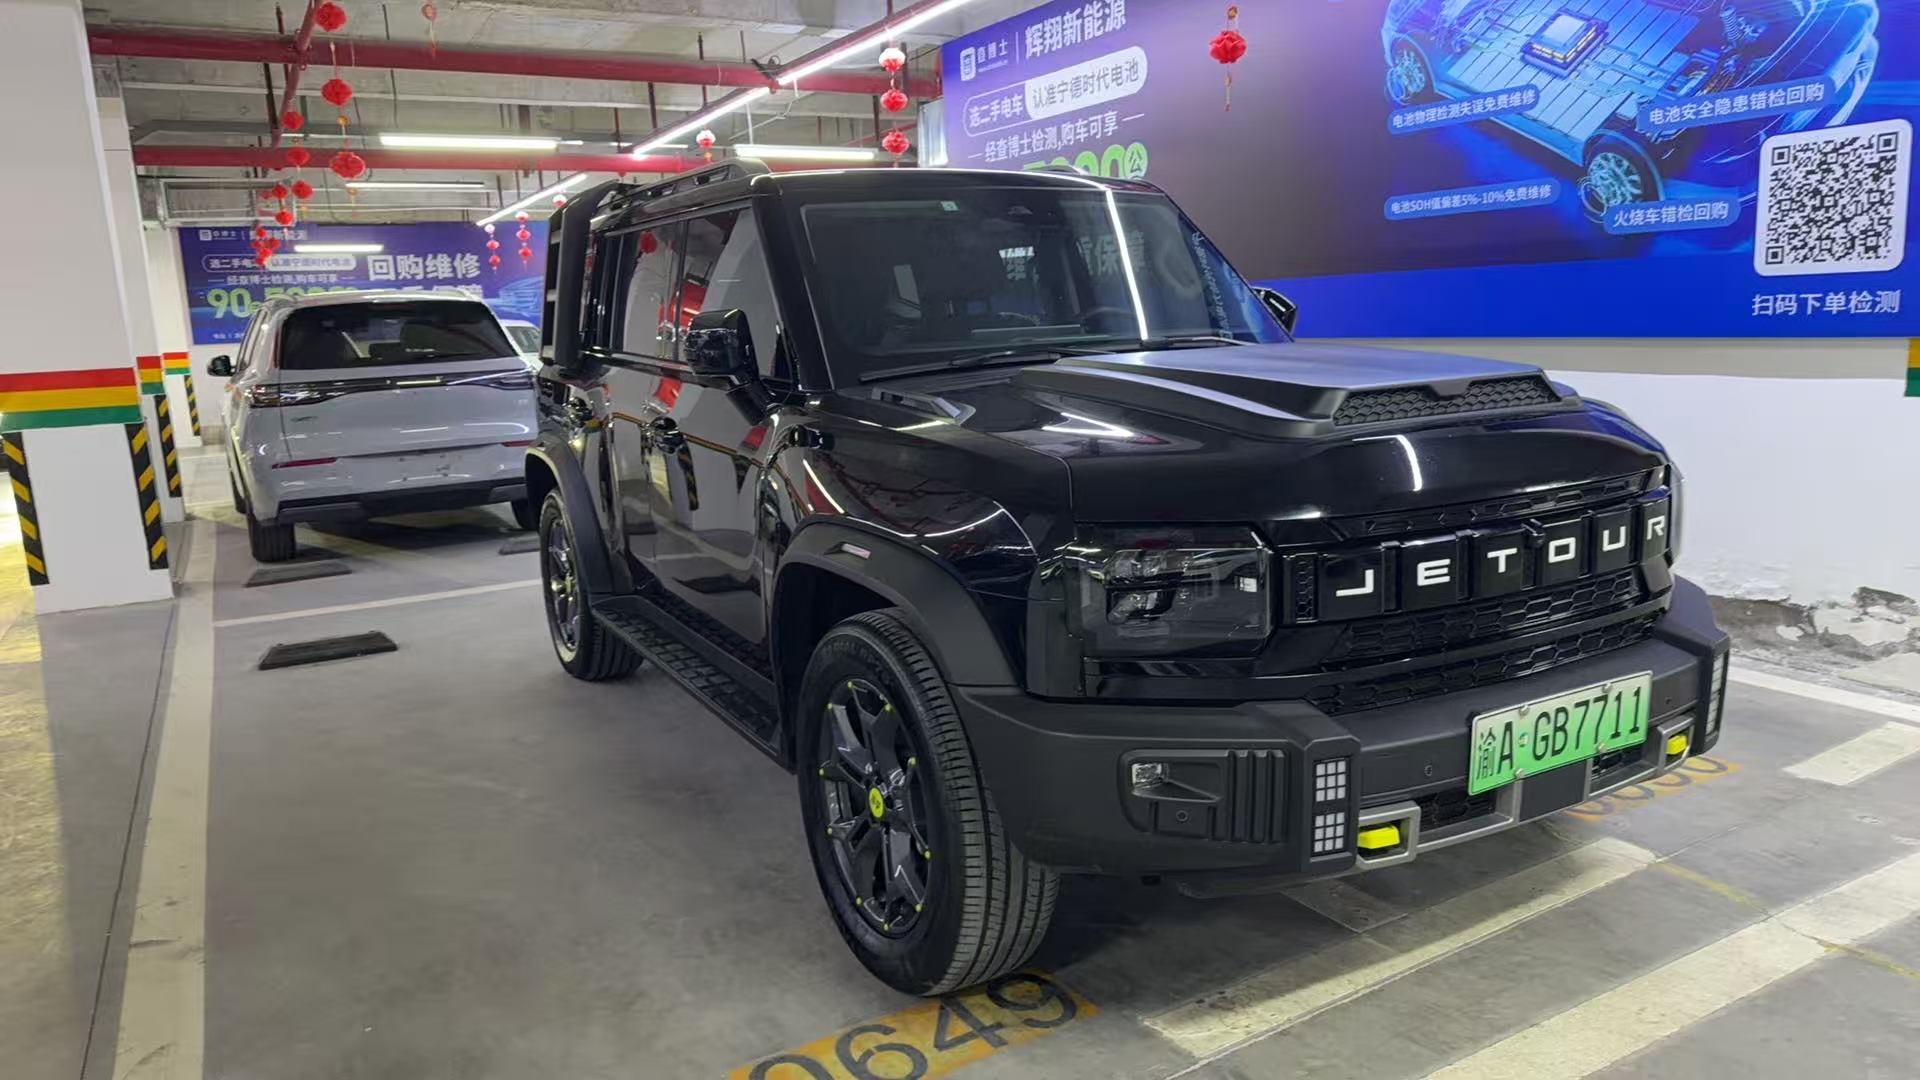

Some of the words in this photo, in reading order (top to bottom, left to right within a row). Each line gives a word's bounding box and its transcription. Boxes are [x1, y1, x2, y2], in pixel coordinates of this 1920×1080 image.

[1025, 0, 1127, 60] 辉翔新能源
[969, 95, 1023, 127] 选二手电车
[1032, 58, 1139, 108] 认准宁德时代电池
[1392, 88, 1536, 128] 电池物理检测失误免费维修
[1649, 82, 1825, 125] 电池安全隐患错检回购
[1613, 202, 1729, 227] 火烧车错检回购
[367, 252, 481, 281] 回购维修
[1752, 289, 1902, 316] 扫码下单检测
[1335, 513, 1666, 599] JETOUR
[1531, 685, 1642, 762] GB7711
